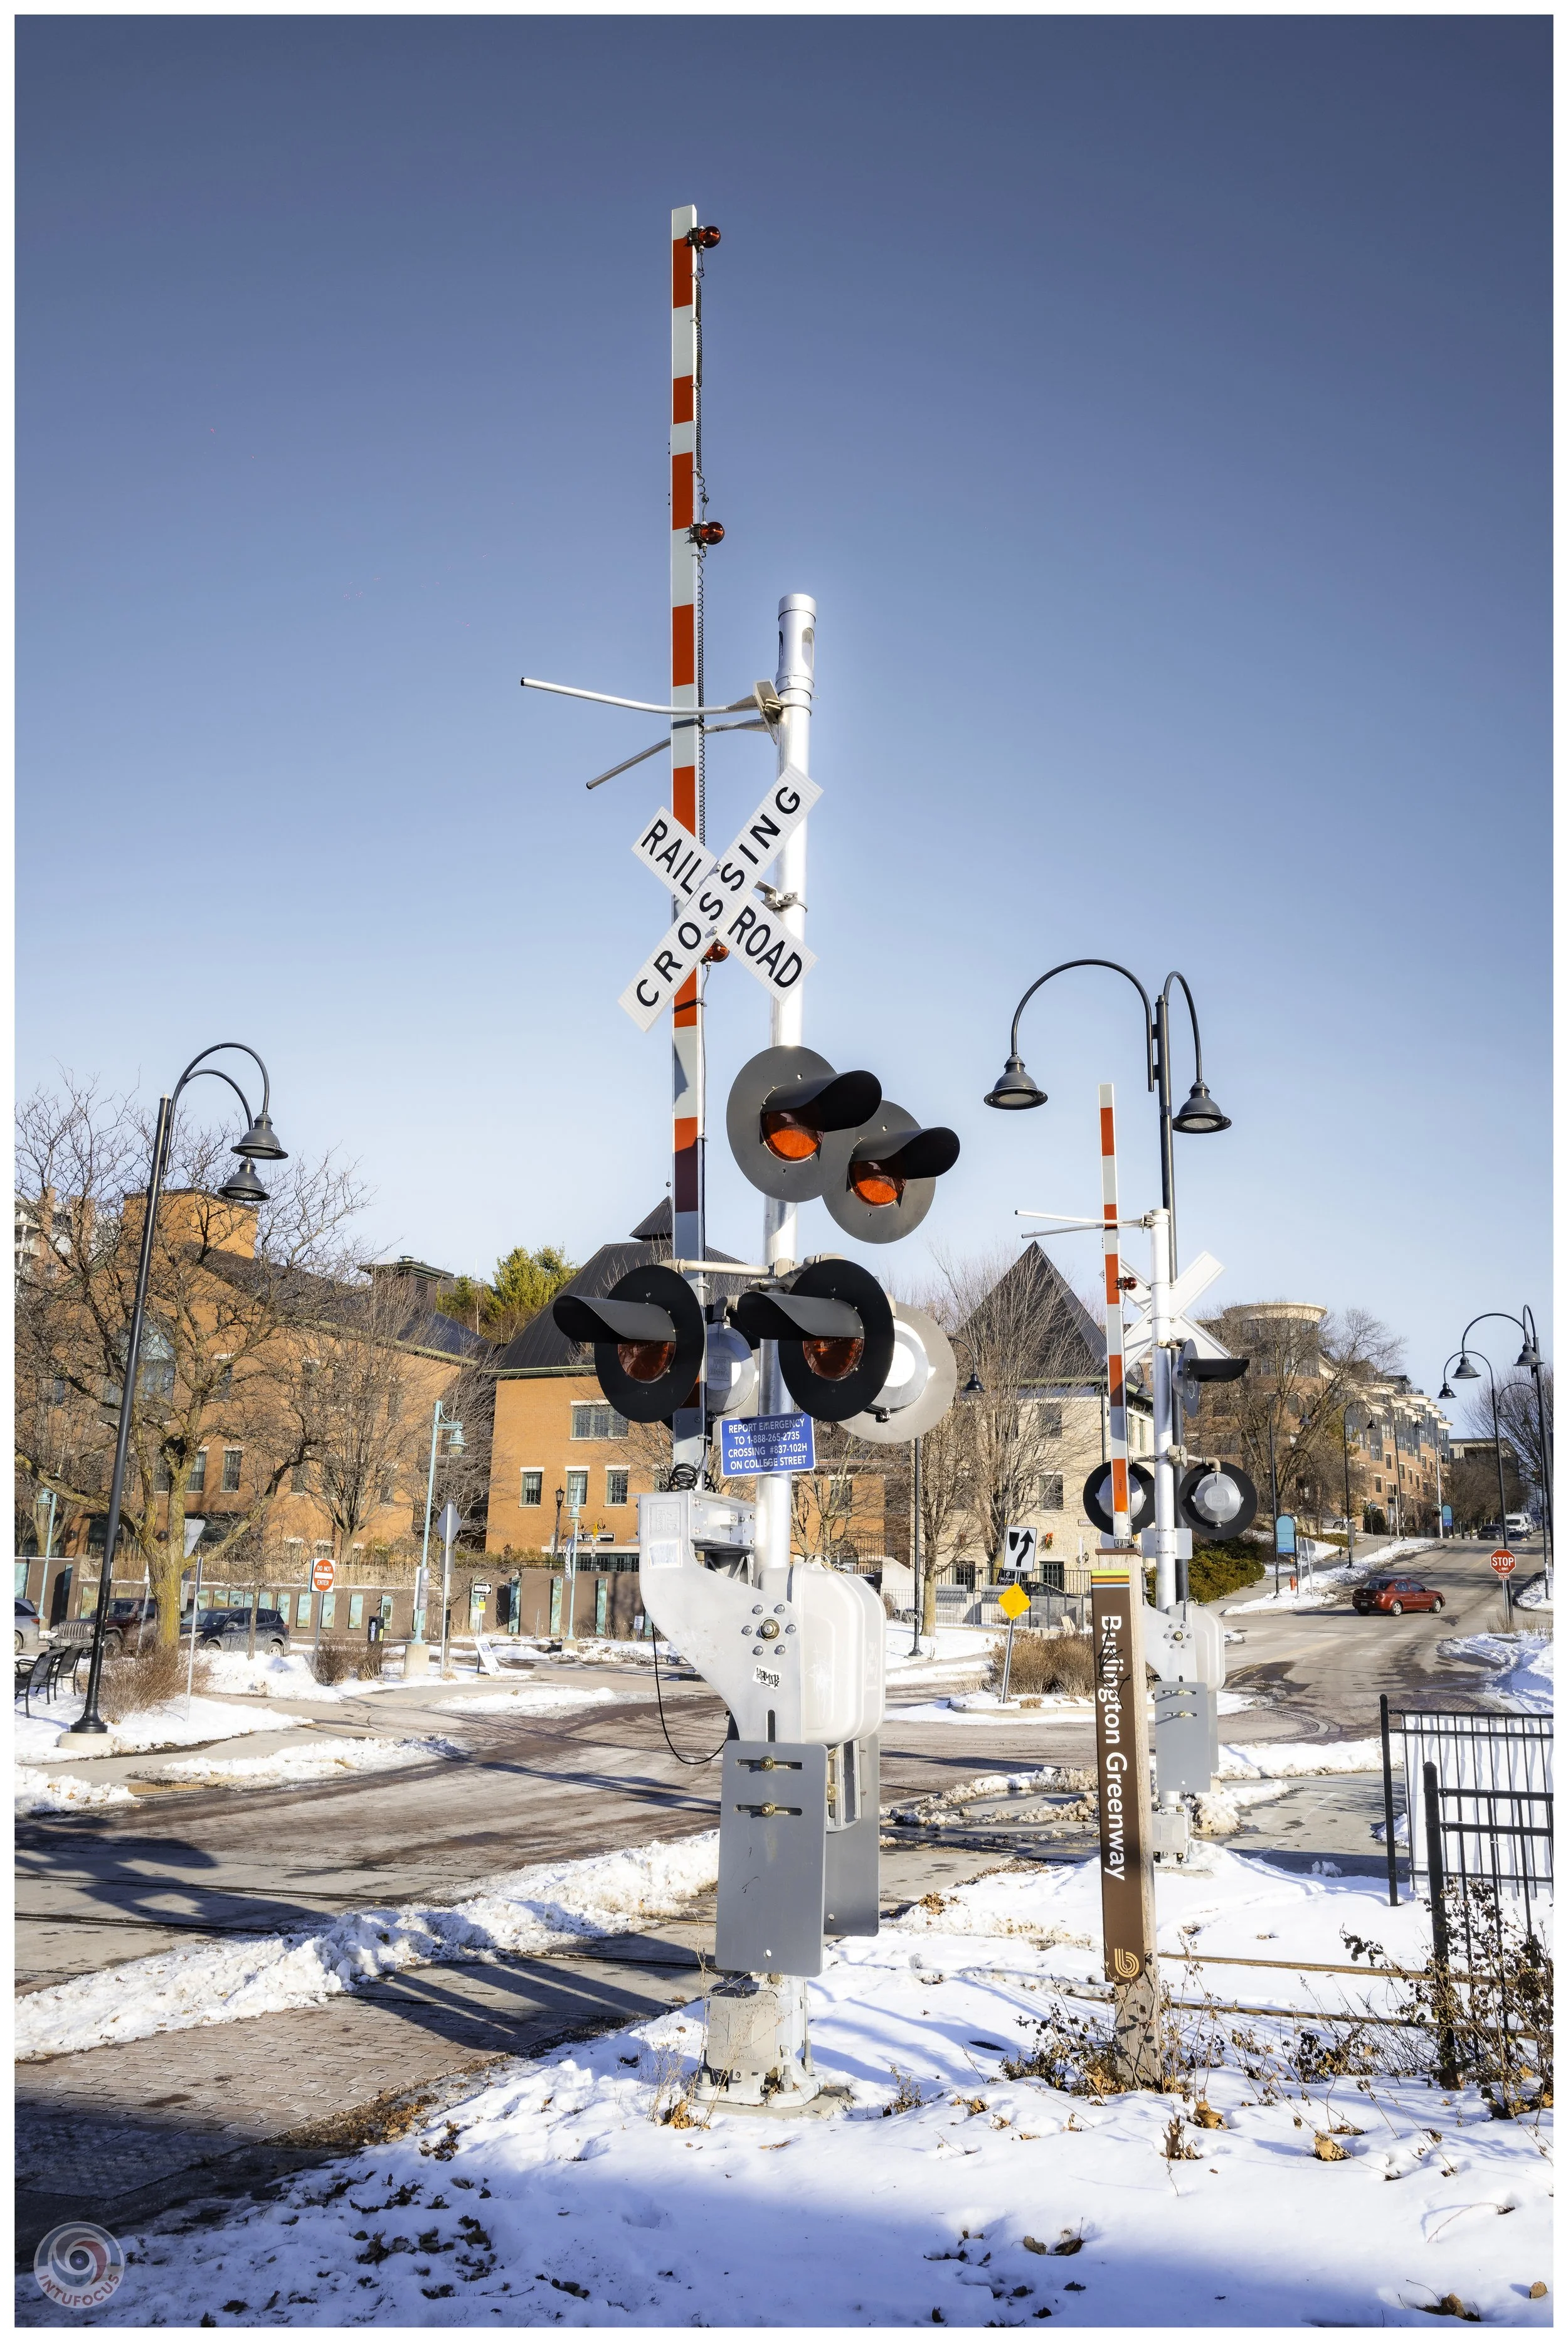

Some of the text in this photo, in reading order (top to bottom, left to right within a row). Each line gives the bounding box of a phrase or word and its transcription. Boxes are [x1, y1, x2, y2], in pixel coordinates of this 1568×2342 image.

[635, 785, 801, 1008] CROSSING
[640, 819, 803, 988] RAIL ROAD
[728, 1418, 805, 1434] REPORT EMERGENCY
[734, 1431, 800, 1445] TO 1-888-265-2735
[728, 1443, 807, 1458] CROSSING #837-102H
[730, 1456, 807, 1470] ON COLLEGE STREET
[1492, 1557, 1514, 1567] STOP
[1098, 1615, 1128, 1881] Burlington Greenway
